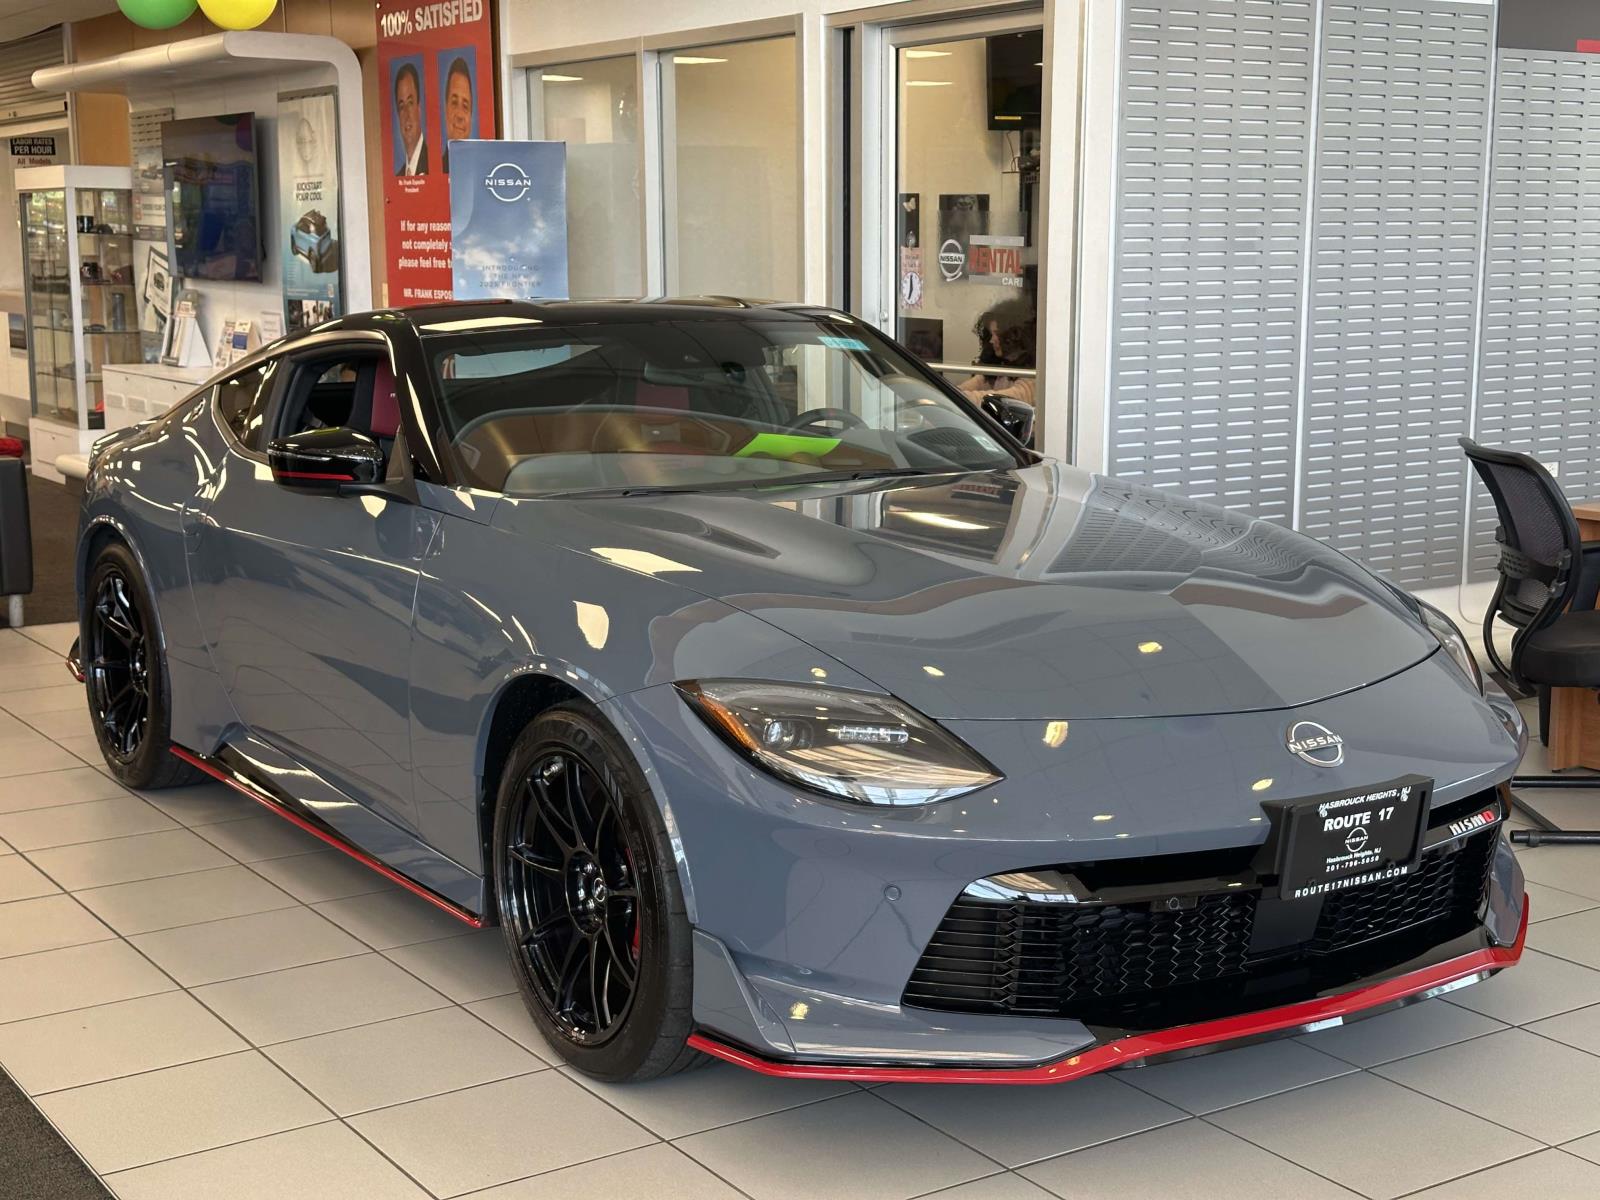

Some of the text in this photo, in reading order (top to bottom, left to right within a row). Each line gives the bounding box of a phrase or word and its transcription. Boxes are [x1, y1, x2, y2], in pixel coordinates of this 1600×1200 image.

[380, 0, 482, 37] 100% SATISFIED
[14, 146, 52, 154] PER HOUR
[296, 181, 322, 191] KICKSTART
[296, 192, 322, 201] YOUR COOL
[401, 220, 452, 234] If for any reason
[402, 240, 412, 249] not
[414, 239, 448, 252] completely
[399, 256, 418, 270] please
[420, 256, 432, 268] feel
[433, 257, 446, 268] free
[969, 246, 1022, 274] RENTAL
[1002, 277, 1018, 286] CAR
[404, 288, 413, 298] MR.
[415, 289, 433, 298] FRANK
[1289, 734, 1342, 753] NISSAN
[1318, 796, 1365, 811] HASBROUCK
[1324, 806, 1394, 831] ROUTE 17
[1345, 836, 1368, 844] NISSAN
[1295, 866, 1408, 898] ROUTE17NISSAN.COM
